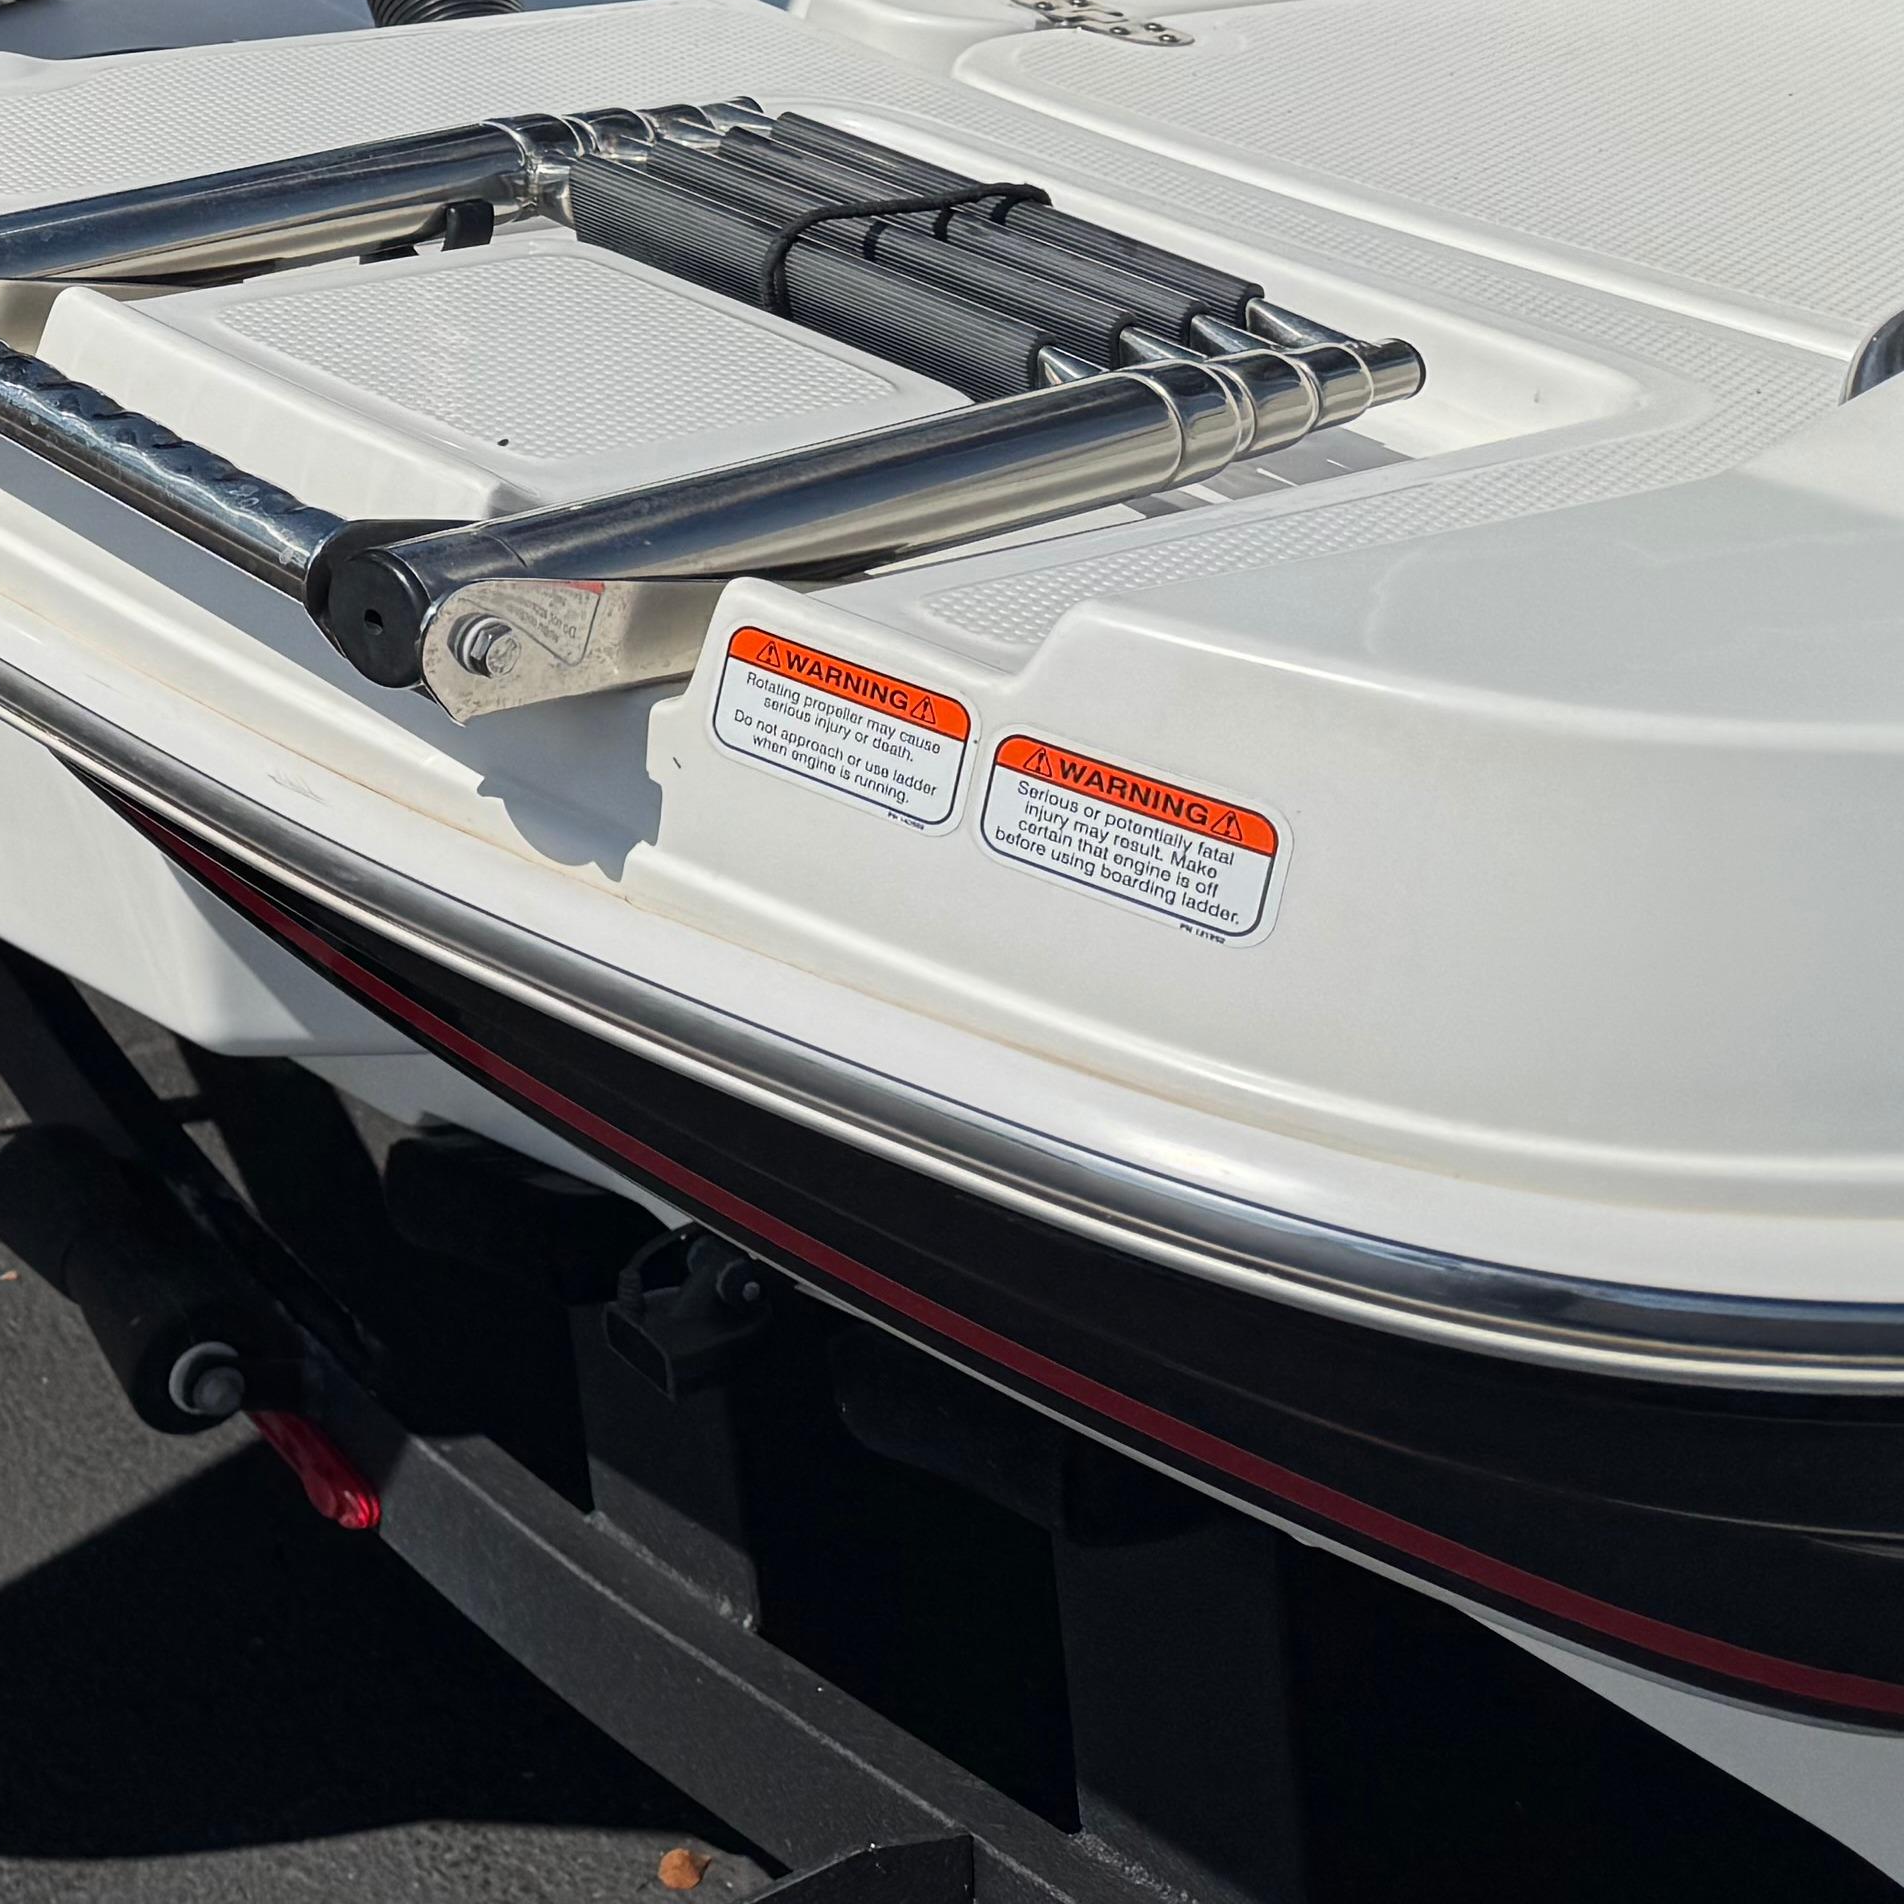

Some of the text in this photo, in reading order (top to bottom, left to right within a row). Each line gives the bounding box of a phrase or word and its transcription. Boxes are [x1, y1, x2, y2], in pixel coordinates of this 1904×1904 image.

[747, 671, 941, 754] Rotating propeller may cause
[786, 650, 909, 711] WARNING
[734, 708, 937, 796] Do not approach or use ladder
[764, 697, 914, 762] serious injury or death.
[753, 734, 910, 805] when engine is running.
[1059, 758, 1209, 826] WARNING
[1017, 780, 1235, 866] Serious or potentially fatal
[1018, 819, 1219, 898] certain that engine is off
[1024, 801, 1217, 879] injury may result. Make
[995, 825, 1240, 925] before using boarding ladder.
